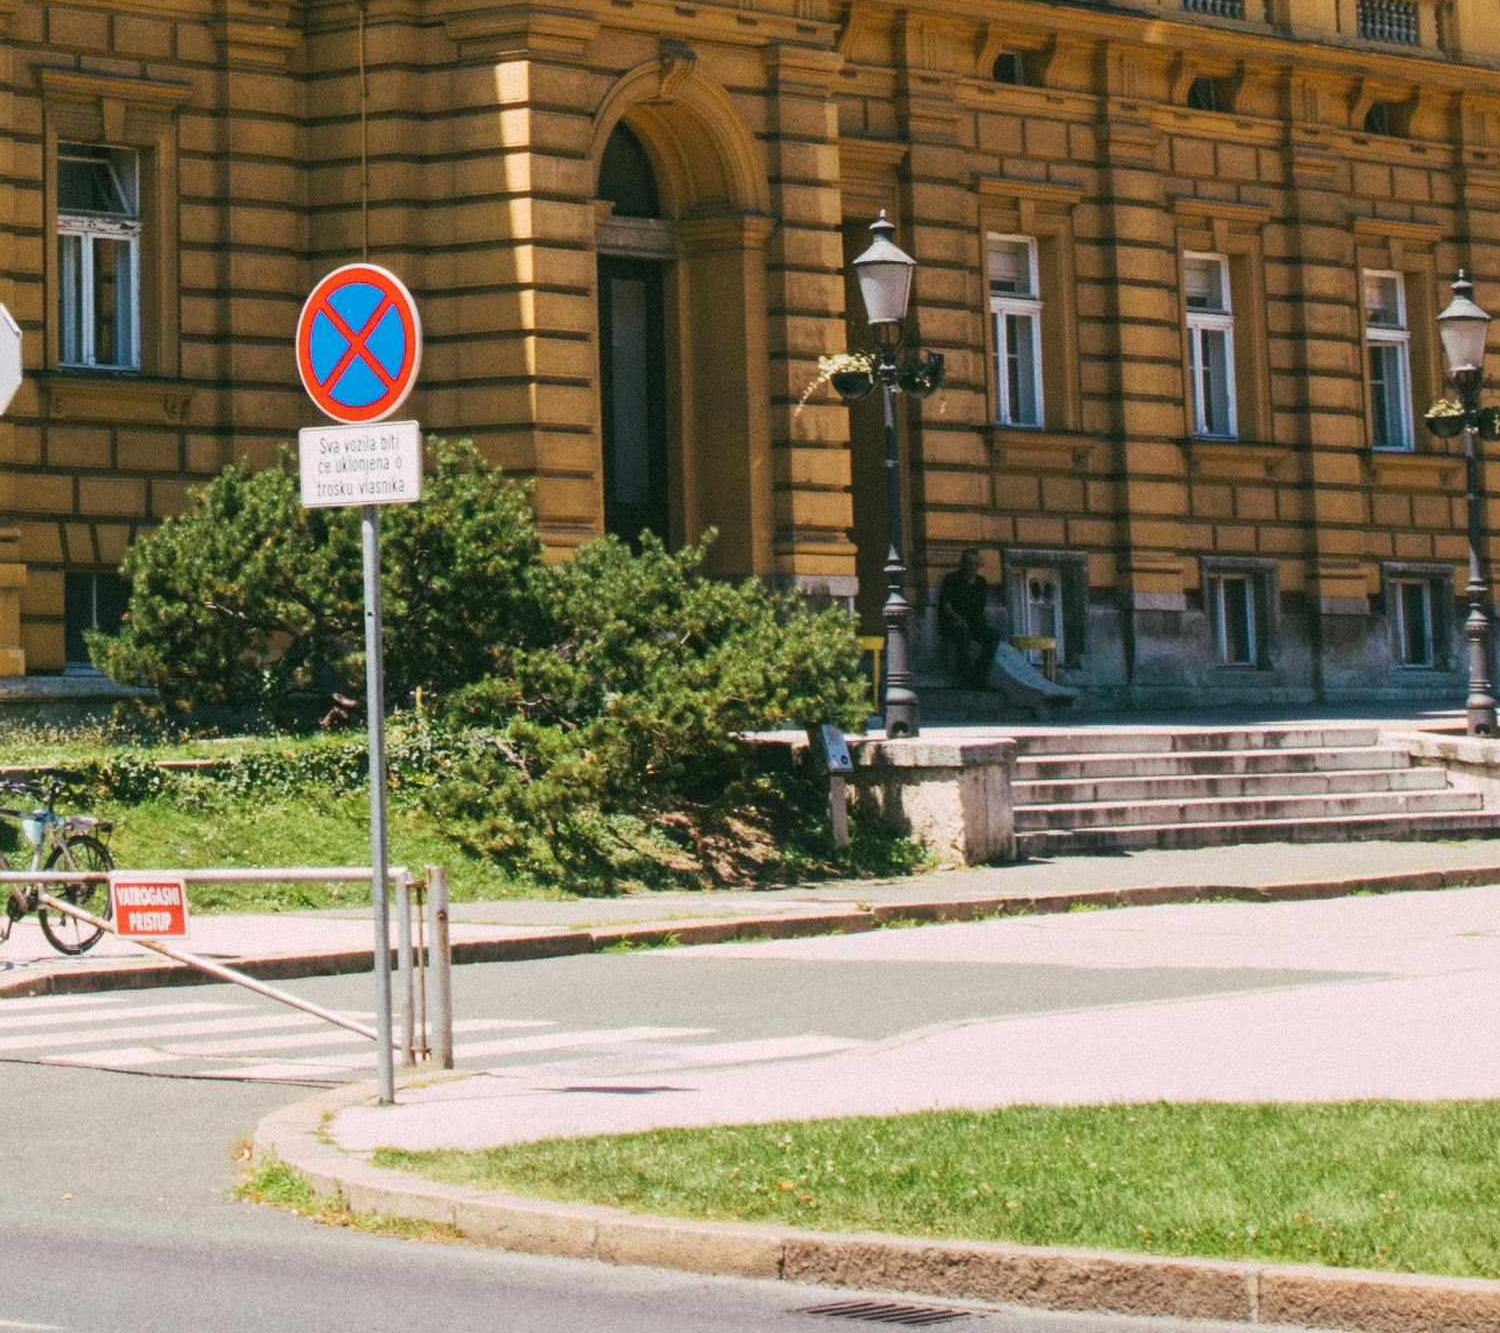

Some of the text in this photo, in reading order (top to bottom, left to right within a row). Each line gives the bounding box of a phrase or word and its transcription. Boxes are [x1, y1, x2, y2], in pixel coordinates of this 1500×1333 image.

[319, 433, 400, 455] Sva vozila biti
[335, 455, 390, 476] uklonjena
[395, 455, 402, 469] o
[359, 476, 405, 495] vlasnika
[116, 886, 181, 906] VATROGASNI
[128, 911, 172, 931] PRISTUP
